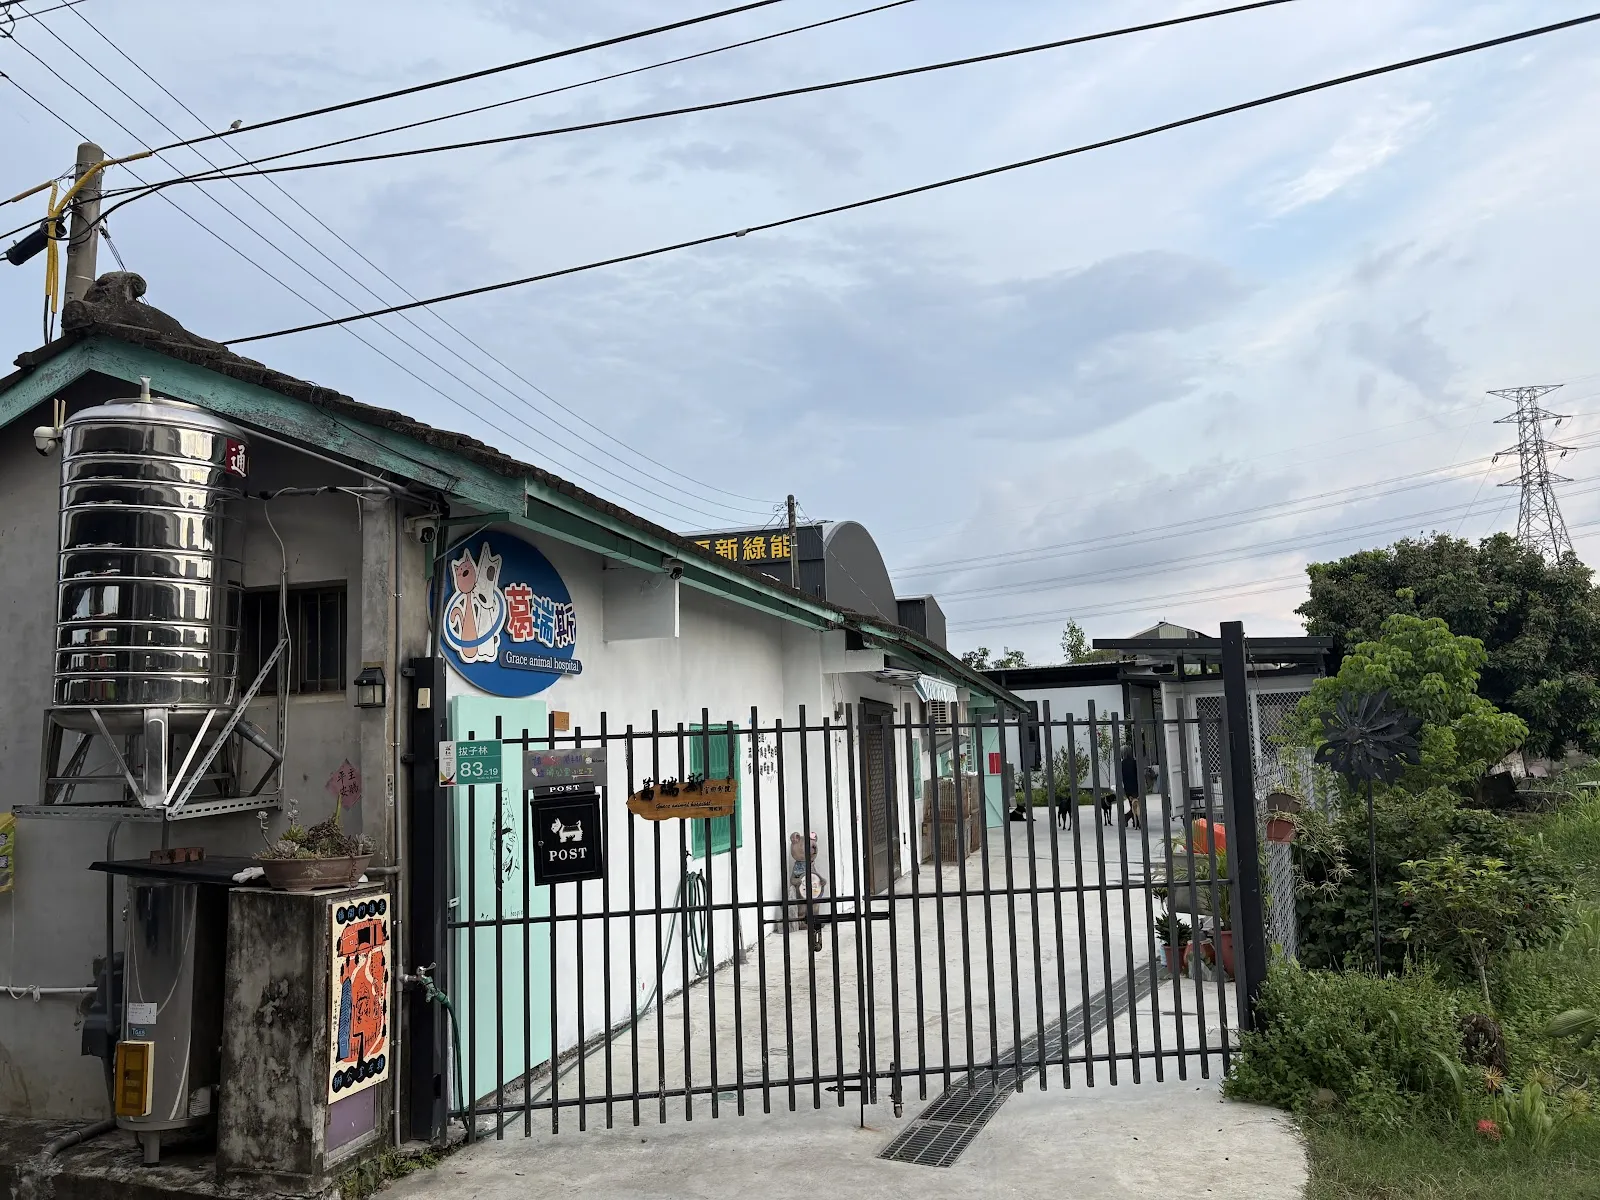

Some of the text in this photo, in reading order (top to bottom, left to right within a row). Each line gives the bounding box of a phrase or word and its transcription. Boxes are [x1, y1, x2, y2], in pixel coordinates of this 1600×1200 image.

[230, 444, 247, 478] 通
[695, 534, 792, 562] 新綠能
[505, 583, 577, 648] 葛瑞斯
[506, 651, 579, 673] Grace animal hospital
[458, 746, 488, 756] 拔子林
[549, 784, 580, 793] POST
[549, 847, 588, 862] POST
